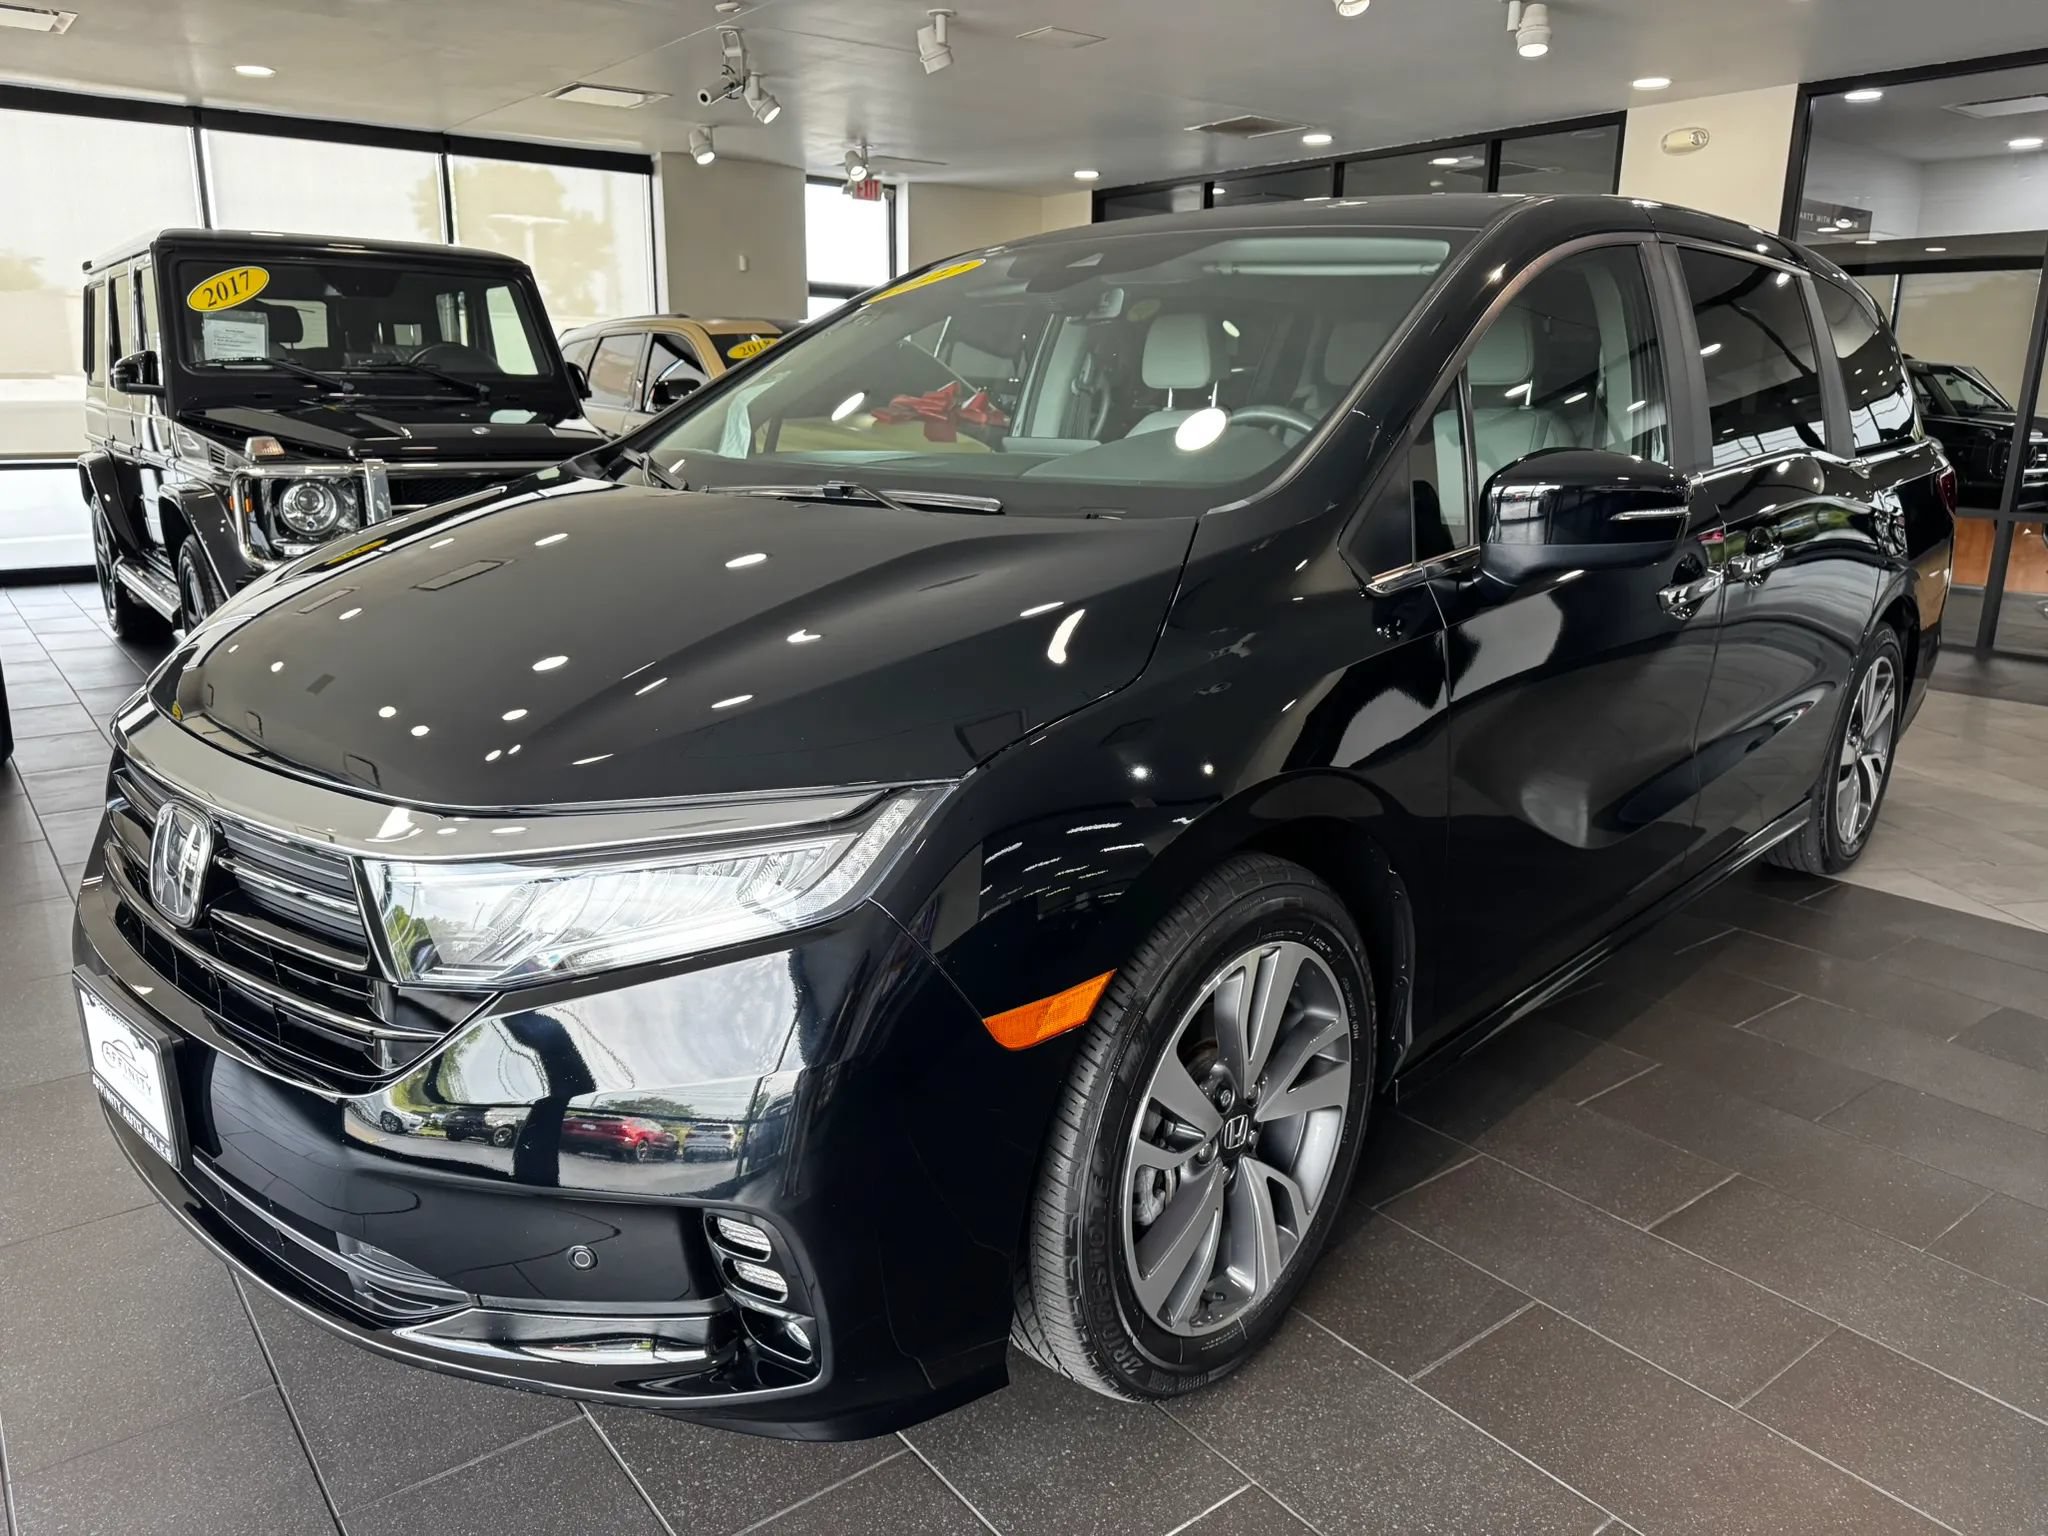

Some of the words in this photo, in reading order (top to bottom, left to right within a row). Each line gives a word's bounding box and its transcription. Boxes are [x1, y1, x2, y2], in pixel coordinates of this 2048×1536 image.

[203, 269, 249, 308] 2017
[105, 1046, 153, 1097] AFFINITY
[92, 1073, 122, 1114] AFFINITY
[122, 1106, 143, 1135] AUTO
[143, 1125, 173, 1163] SALES
